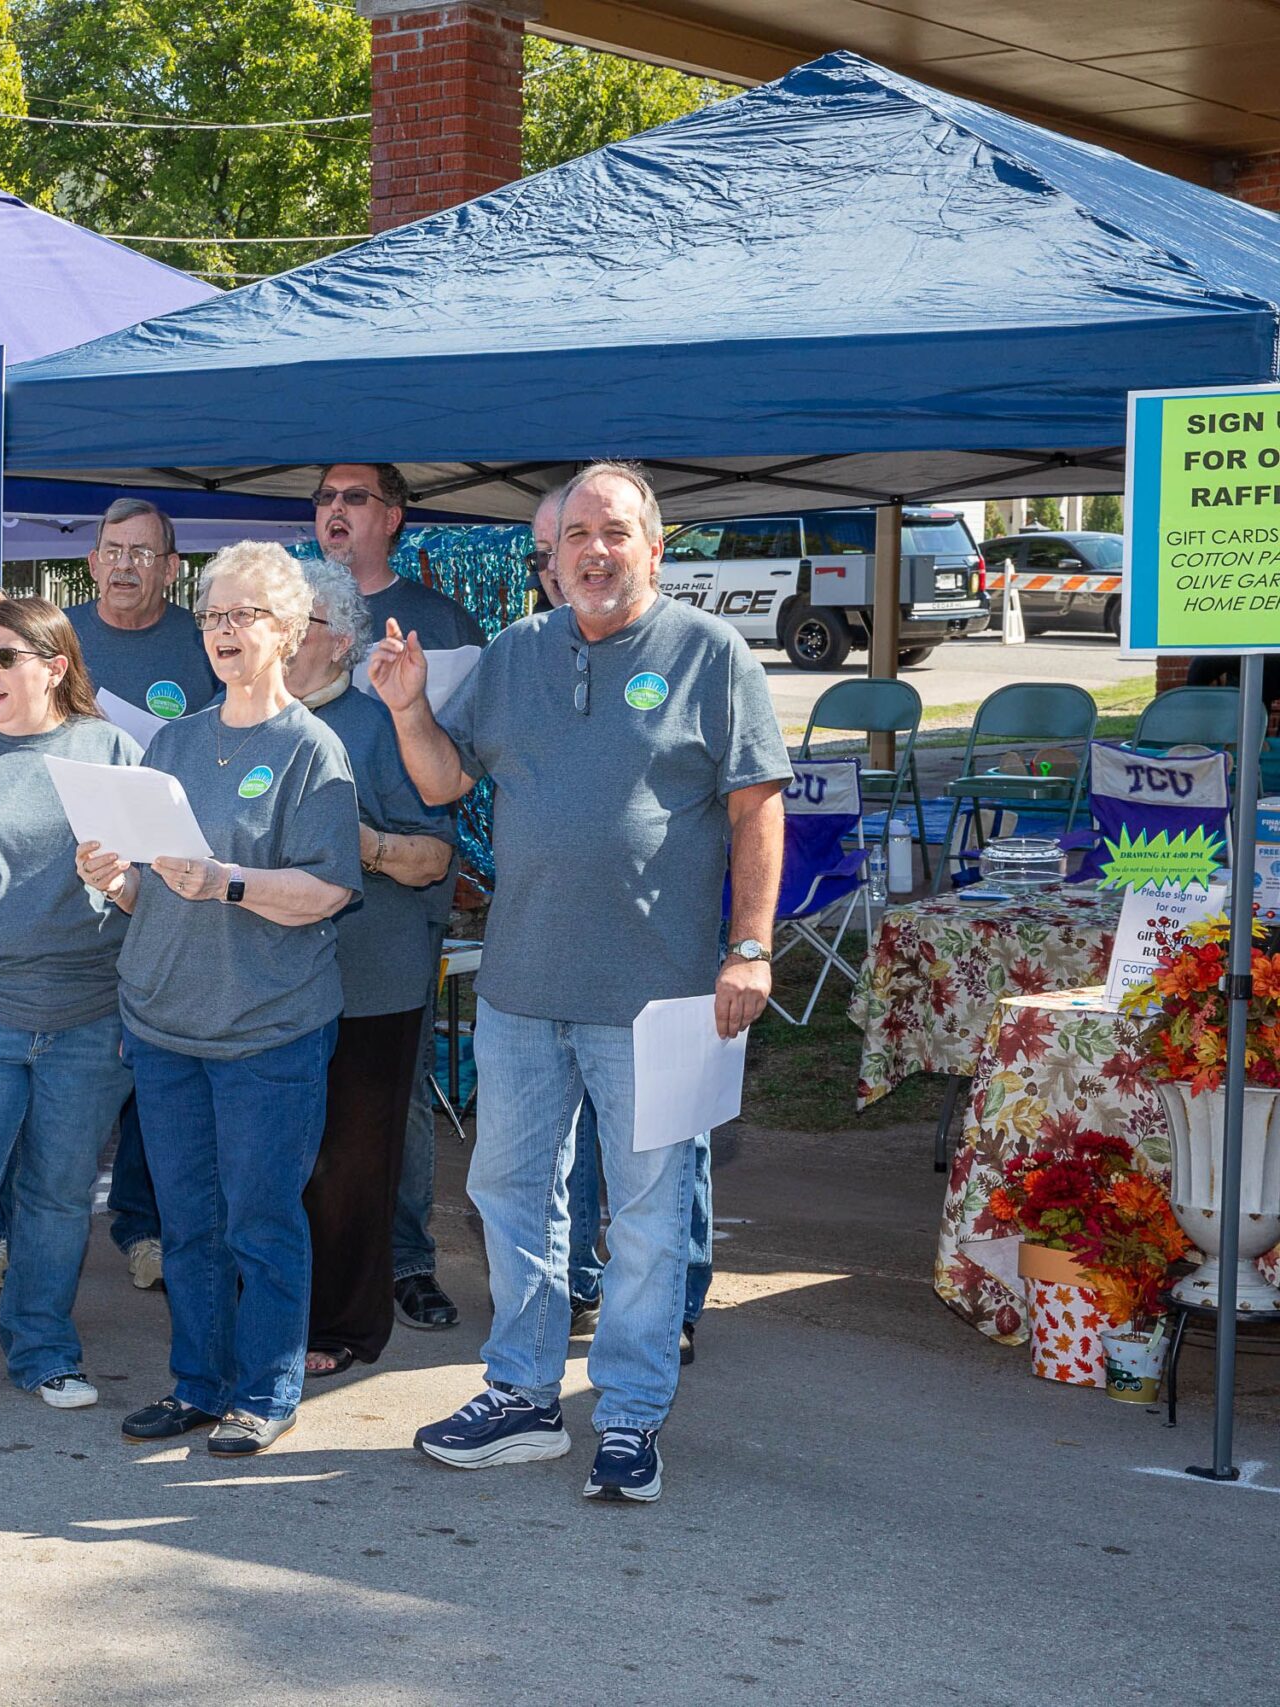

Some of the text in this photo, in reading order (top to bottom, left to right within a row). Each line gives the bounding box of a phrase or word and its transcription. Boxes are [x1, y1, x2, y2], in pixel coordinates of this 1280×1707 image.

[1186, 411, 1264, 434] SIGN
[1184, 449, 1248, 471] FOR
[1166, 527, 1279, 546] GIFT CARDS
[1171, 551, 1254, 568] COTTON
[659, 581, 714, 591] EDAR HILL
[1176, 574, 1234, 590] OLIVE
[662, 589, 778, 615] OLICE
[1184, 596, 1247, 612] HOME
[783, 771, 827, 805] CU
[1125, 764, 1195, 797] TCU
[1119, 851, 1204, 859] DRAWING AT 4:00 PM
[1121, 865, 1129, 873] do
[1140, 865, 1154, 873] need
[1160, 865, 1167, 873] be
[1168, 866, 1190, 874] present
[1140, 887, 1208, 903] Please sign up
[1156, 902, 1187, 913] for our
[1137, 930, 1156, 942] GIF
[1123, 964, 1154, 976] COTTO
